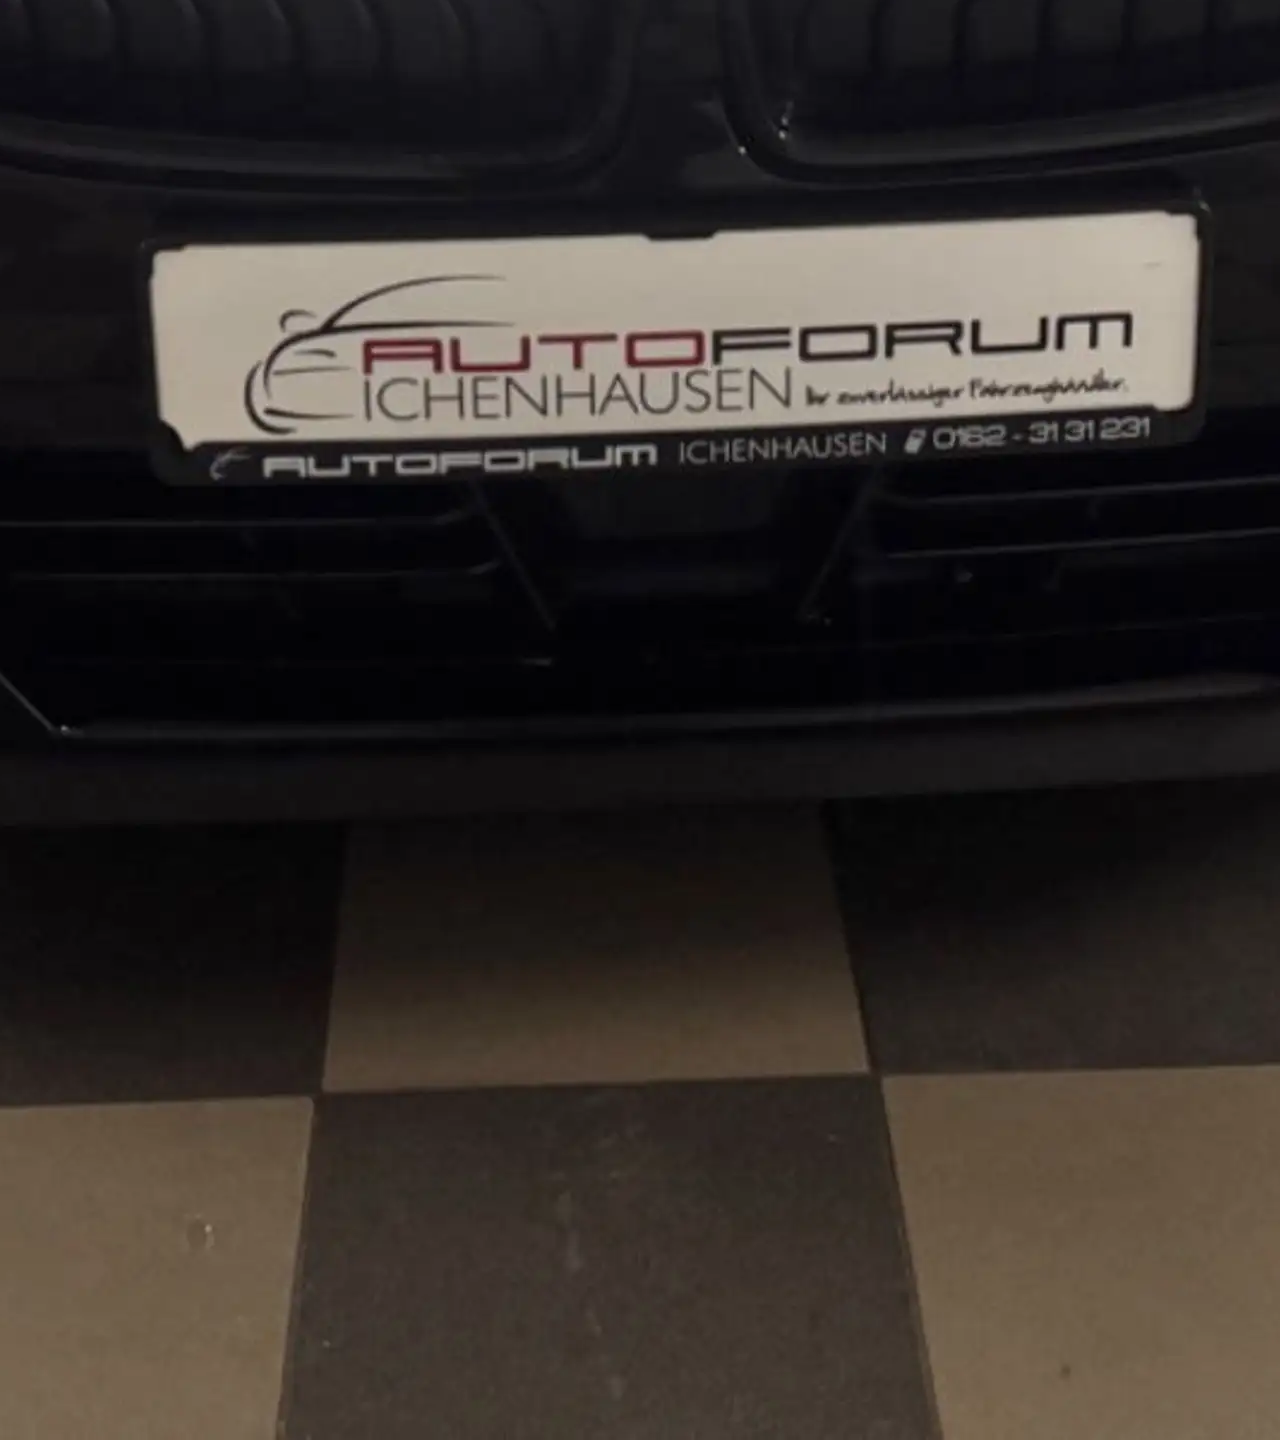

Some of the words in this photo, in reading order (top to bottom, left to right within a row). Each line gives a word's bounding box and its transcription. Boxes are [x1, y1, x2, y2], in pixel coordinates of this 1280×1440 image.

[362, 312, 1133, 375] AUTOFORUM
[363, 367, 792, 422] ICHENHAUSEN
[262, 443, 658, 478] AUTOFORUM
[678, 431, 888, 465] ICHENHAUSEN
